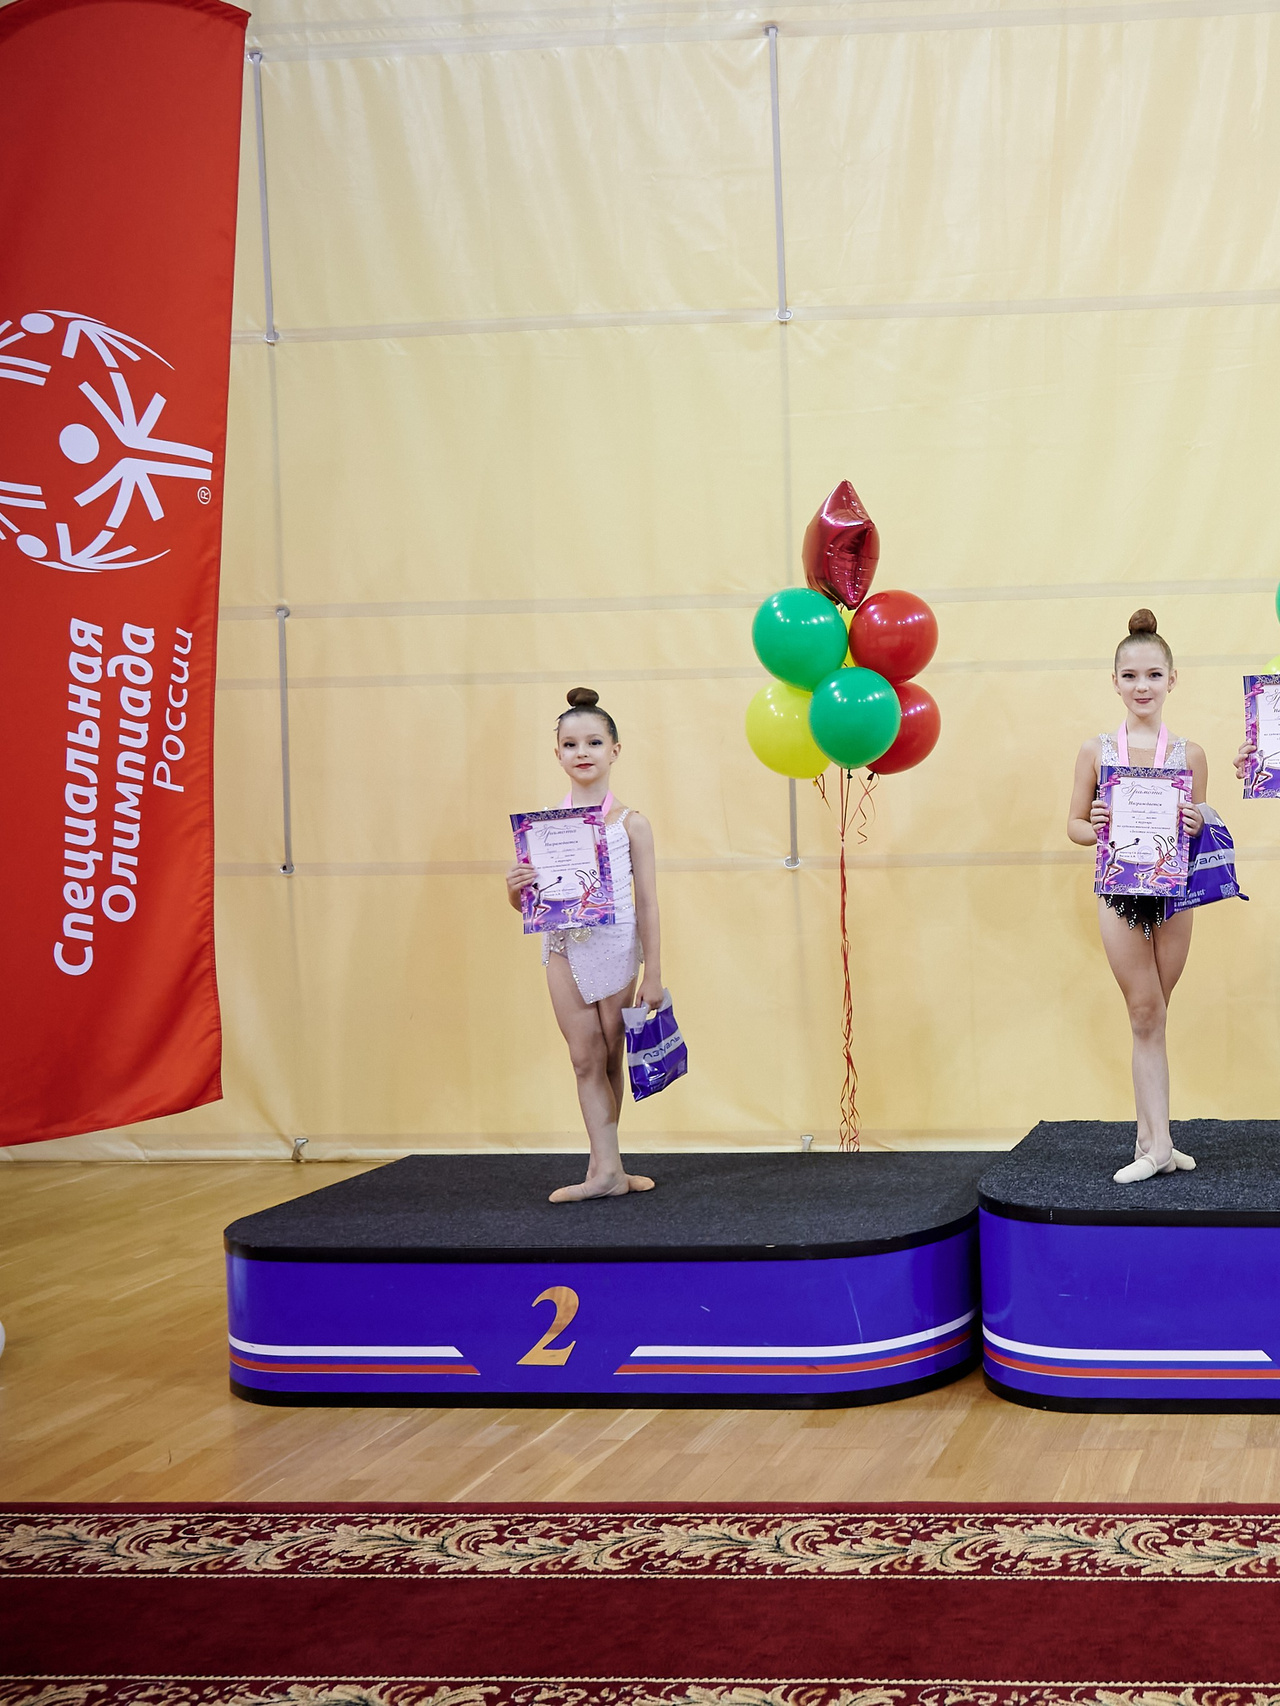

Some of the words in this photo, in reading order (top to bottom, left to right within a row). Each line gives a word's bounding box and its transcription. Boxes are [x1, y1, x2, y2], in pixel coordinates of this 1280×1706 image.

[53, 617, 103, 976] Специальная
[101, 622, 155, 923] Олимпиада
[152, 626, 193, 793] России
[516, 1285, 580, 1366] 2
